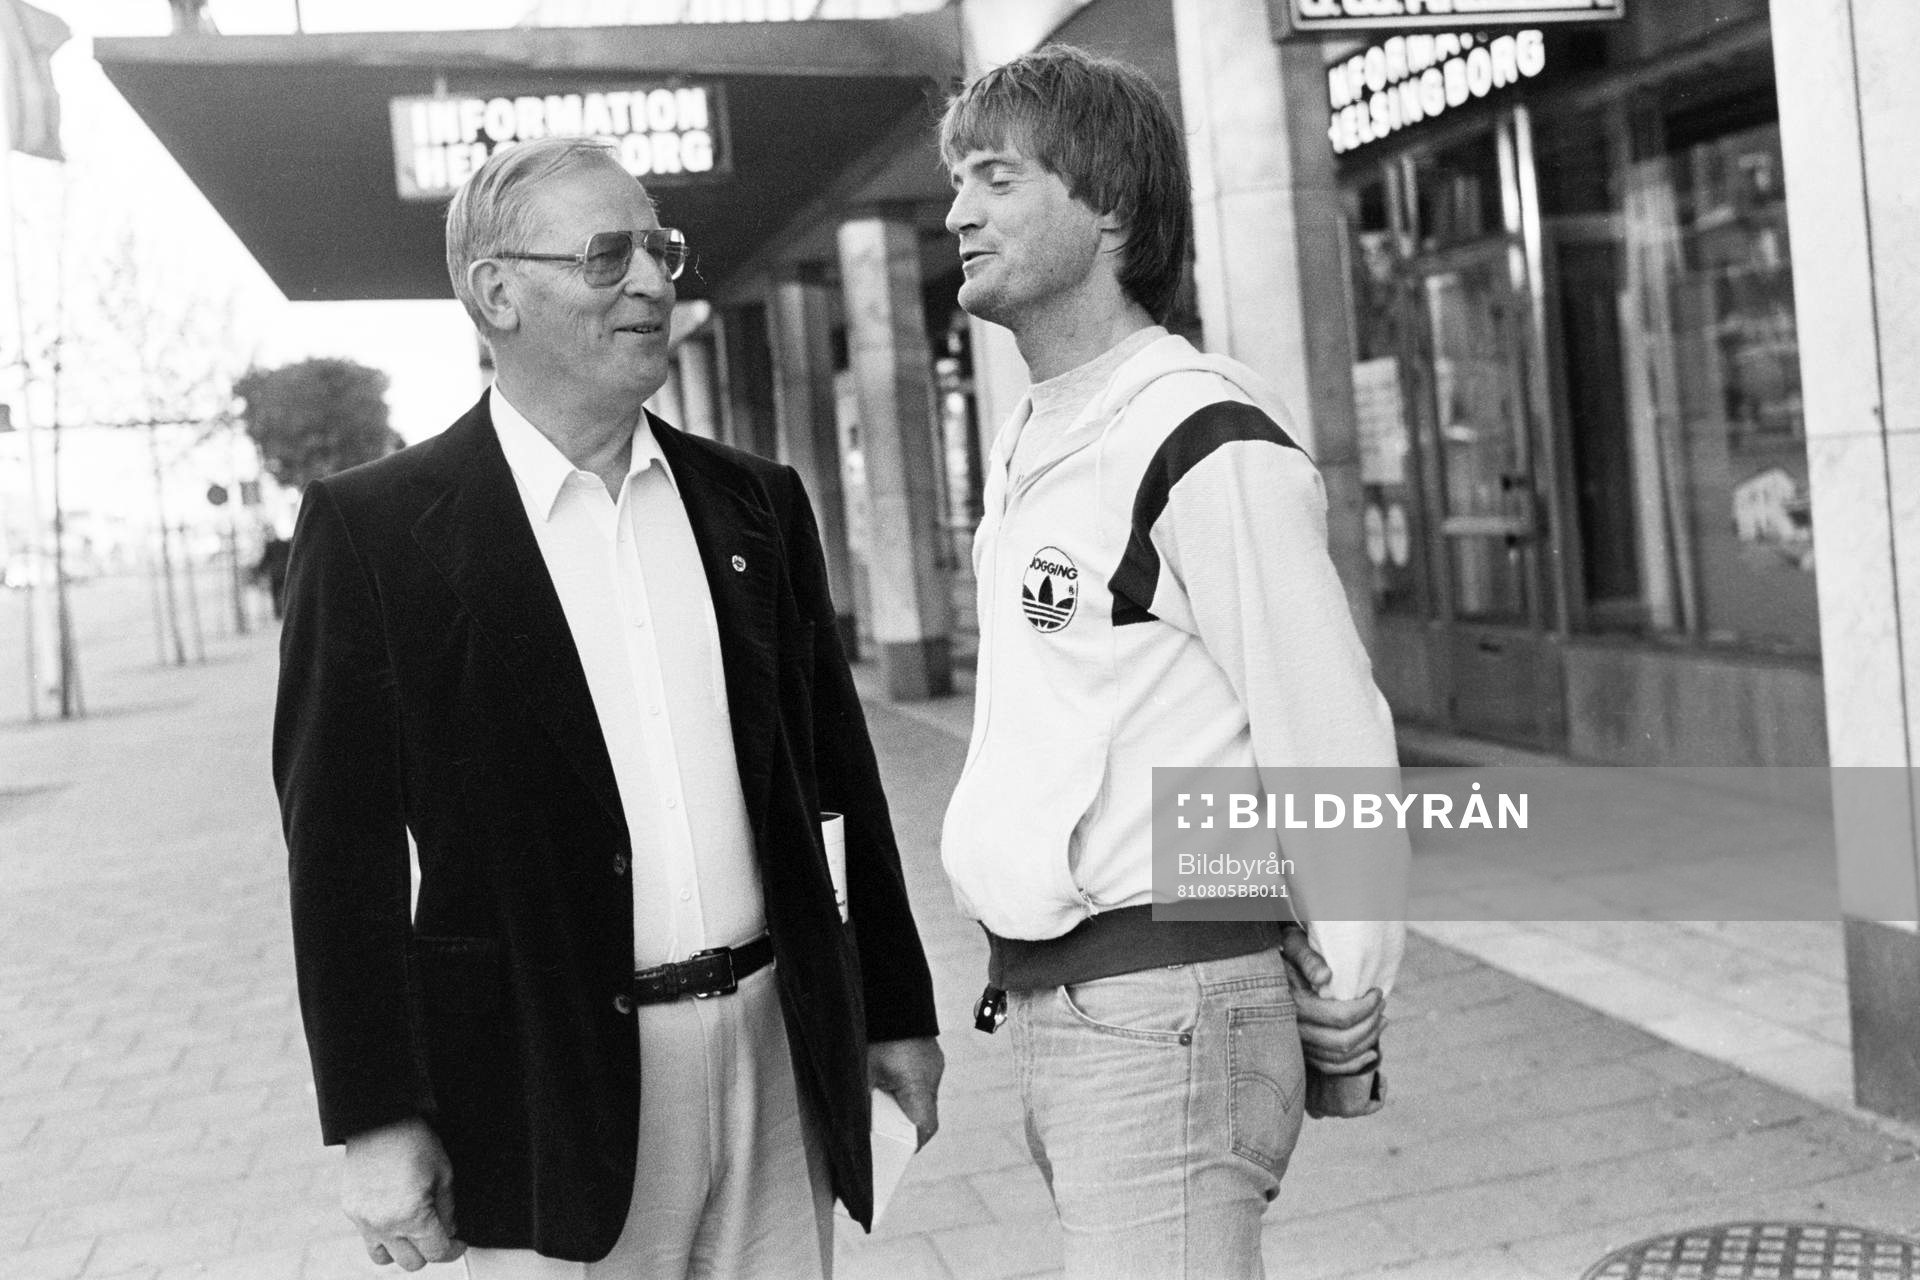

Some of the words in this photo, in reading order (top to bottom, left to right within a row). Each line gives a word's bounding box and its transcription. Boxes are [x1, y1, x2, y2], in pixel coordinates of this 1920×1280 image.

[411, 88, 709, 145] INFORMATION
[414, 130, 714, 190] HELORG
[1029, 557, 1078, 580] JOGGING
